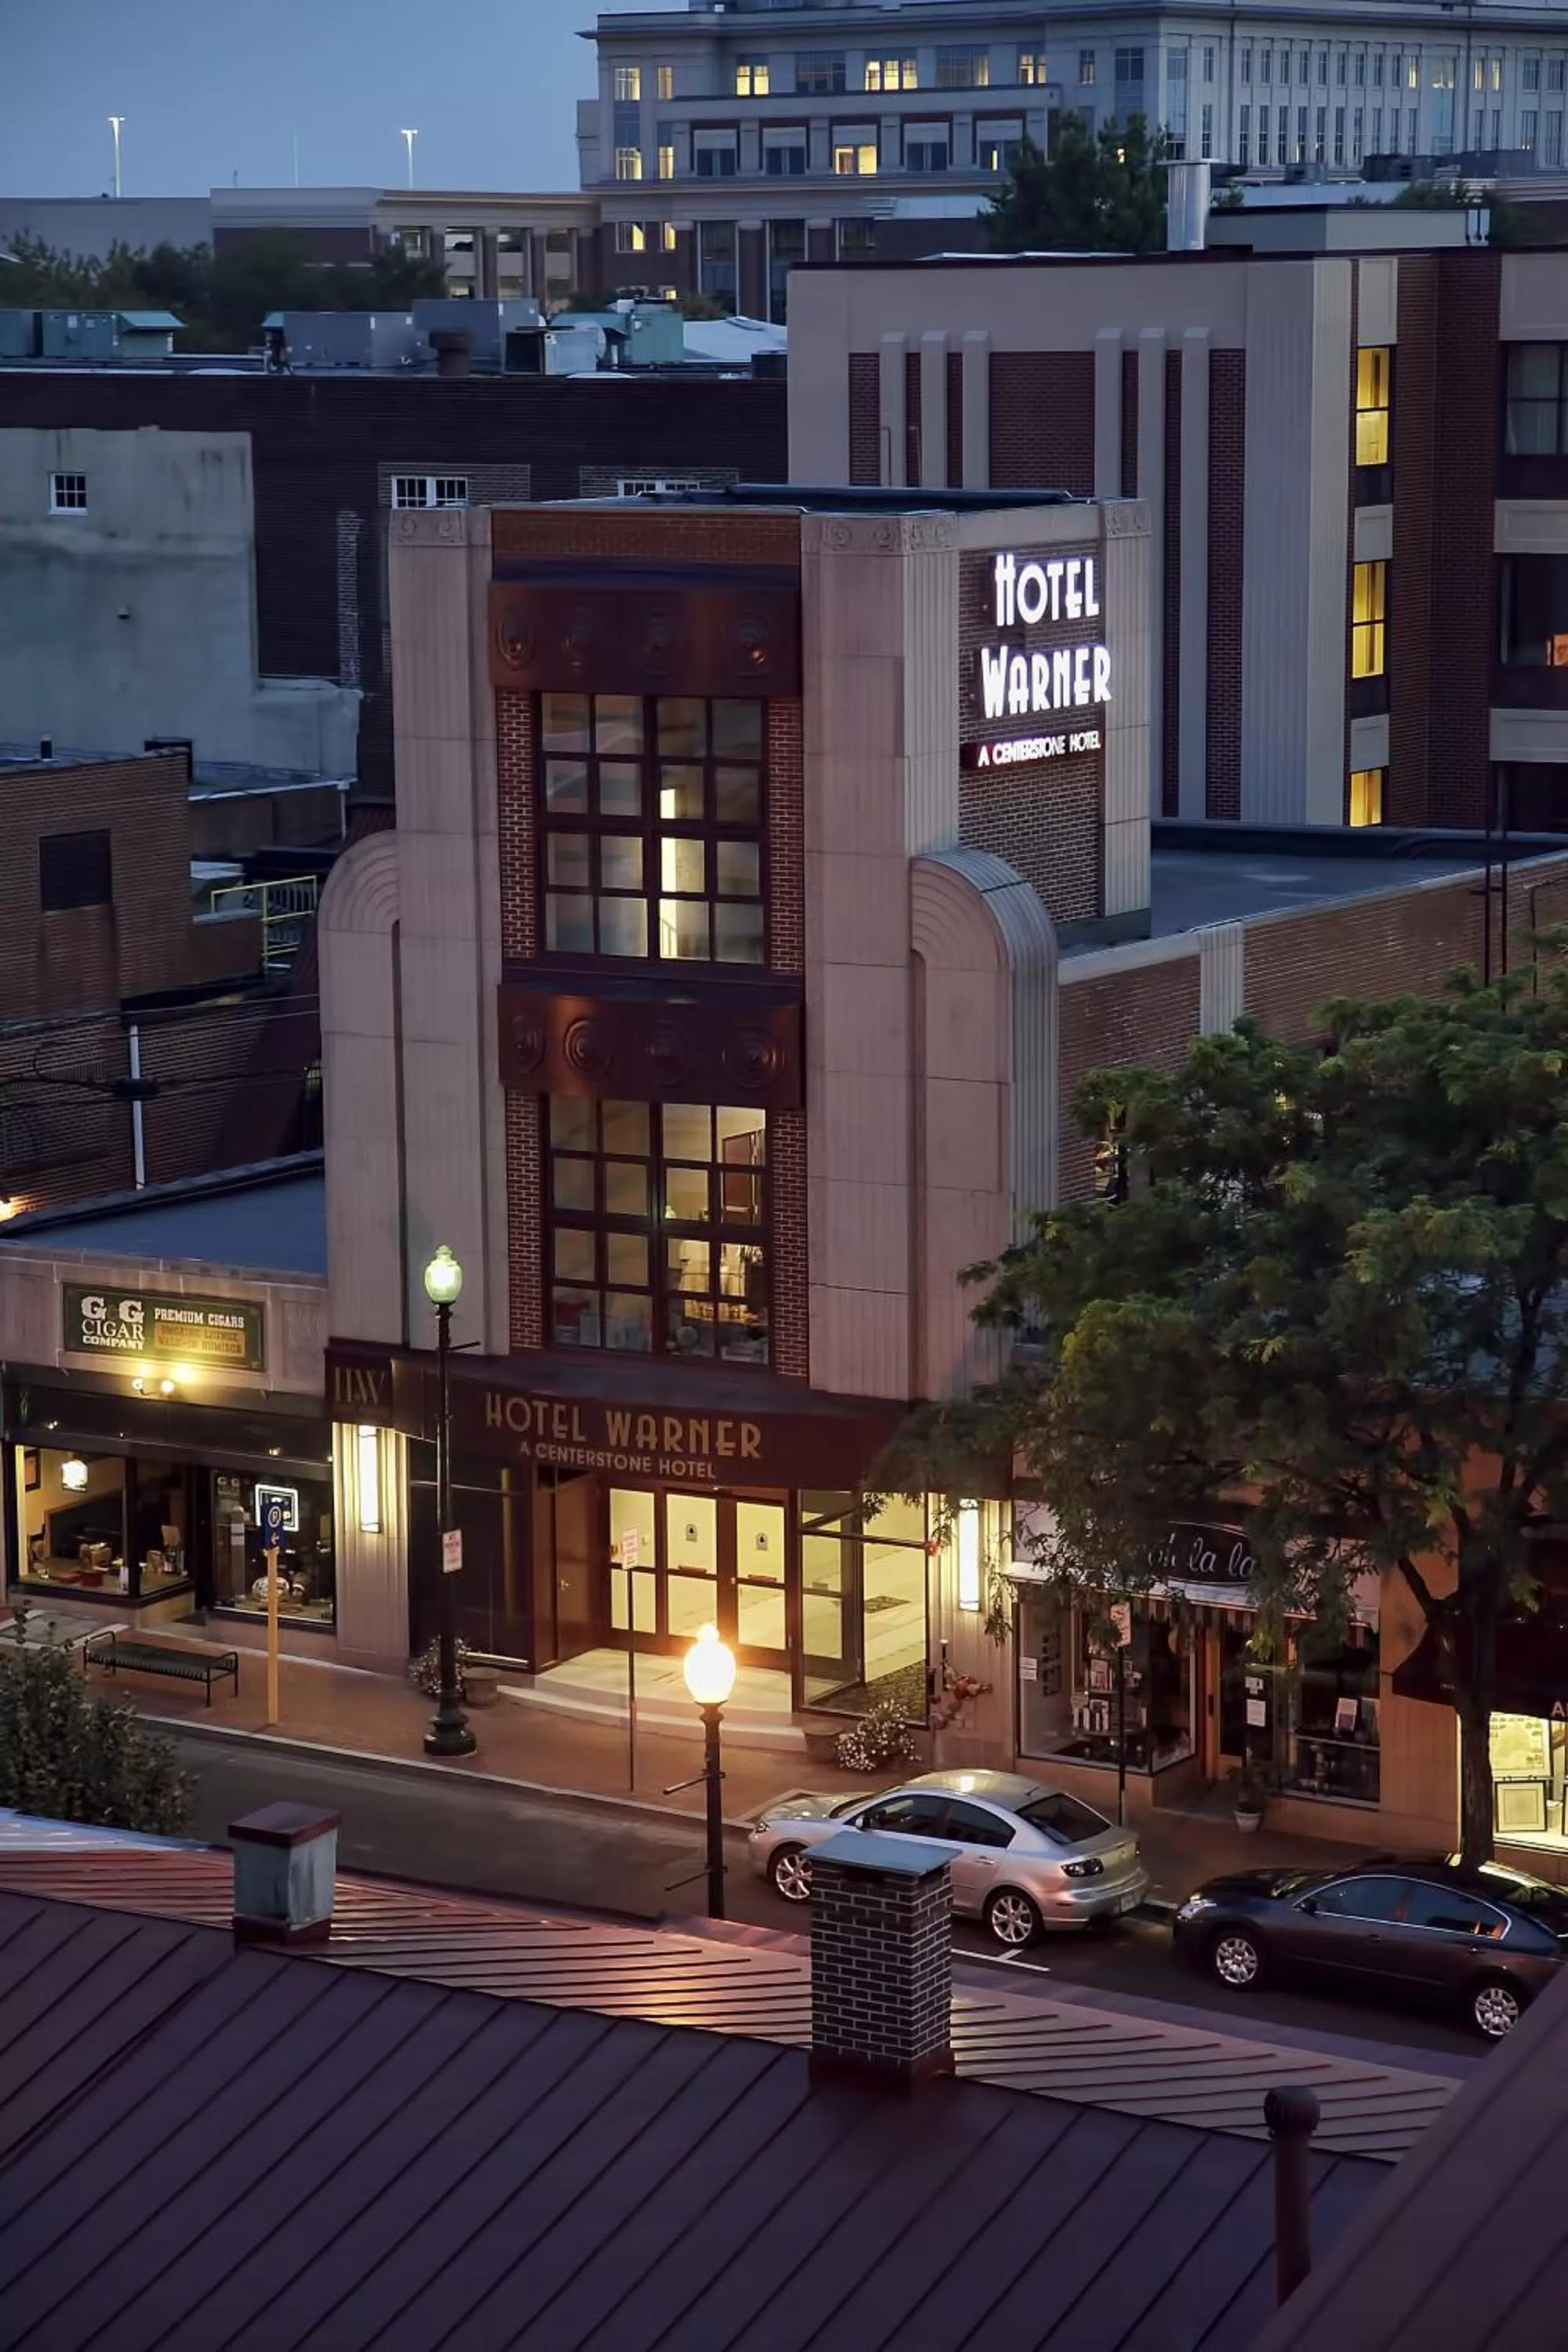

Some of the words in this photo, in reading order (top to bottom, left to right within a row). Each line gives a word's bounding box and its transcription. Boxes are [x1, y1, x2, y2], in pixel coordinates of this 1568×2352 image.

[995, 554, 1099, 626] HOTEL
[981, 644, 1112, 718] WARNER
[978, 745, 990, 767] A
[1069, 730, 1101, 753] HOTEL
[82, 1319, 145, 1340] CIGAR
[154, 1307, 204, 1324] PREMIUM
[208, 1312, 245, 1328] CIGARS
[82, 1335, 144, 1350] COMPANY
[485, 1392, 586, 1442] HOTEL
[606, 1410, 761, 1459] WARNER
[519, 1441, 531, 1456] A
[535, 1443, 652, 1472] CENTERSTONE
[659, 1458, 716, 1479] HOTEL
[1189, 1537, 1217, 1573] la
[1551, 1700, 1568, 1718] A
